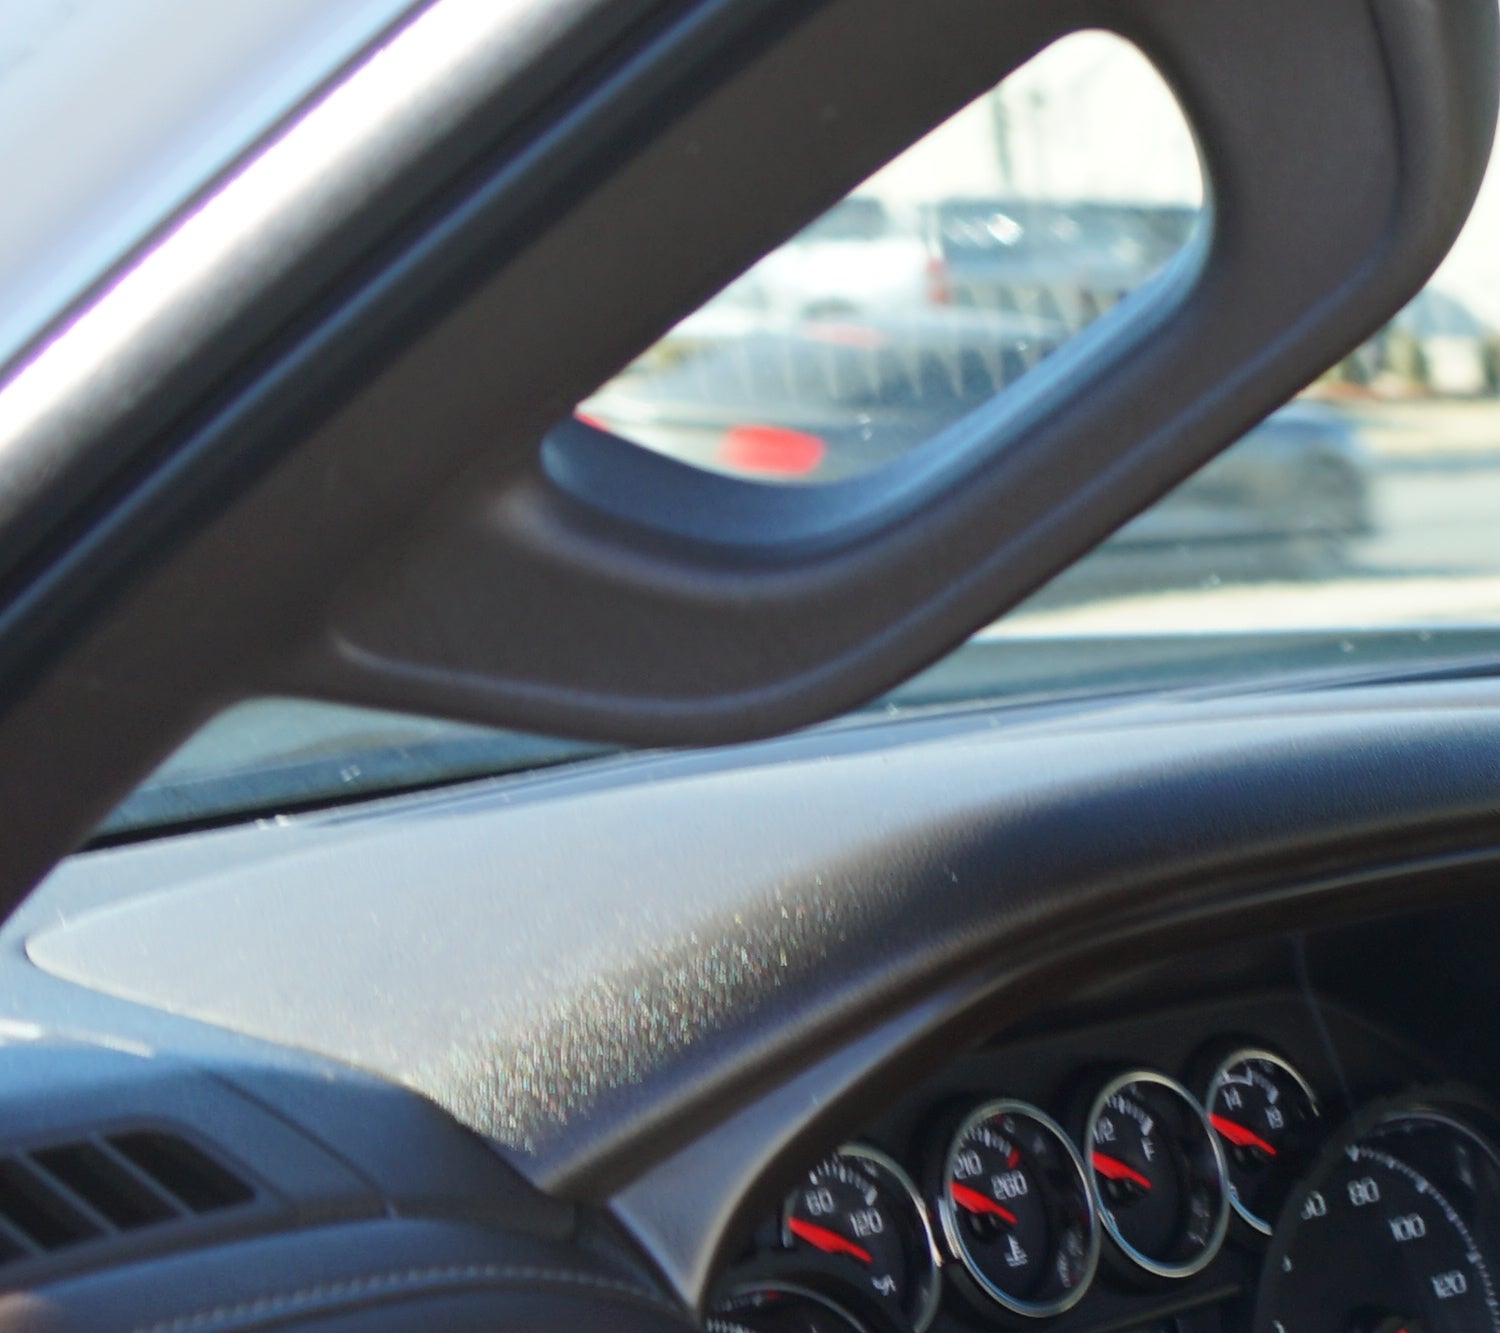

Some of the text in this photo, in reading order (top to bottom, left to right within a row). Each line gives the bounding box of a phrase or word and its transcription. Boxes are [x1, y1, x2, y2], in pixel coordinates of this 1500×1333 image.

[1347, 1177, 1380, 1206] 80
[1389, 1213, 1426, 1242] 100
[1431, 1270, 1468, 1299] 120
